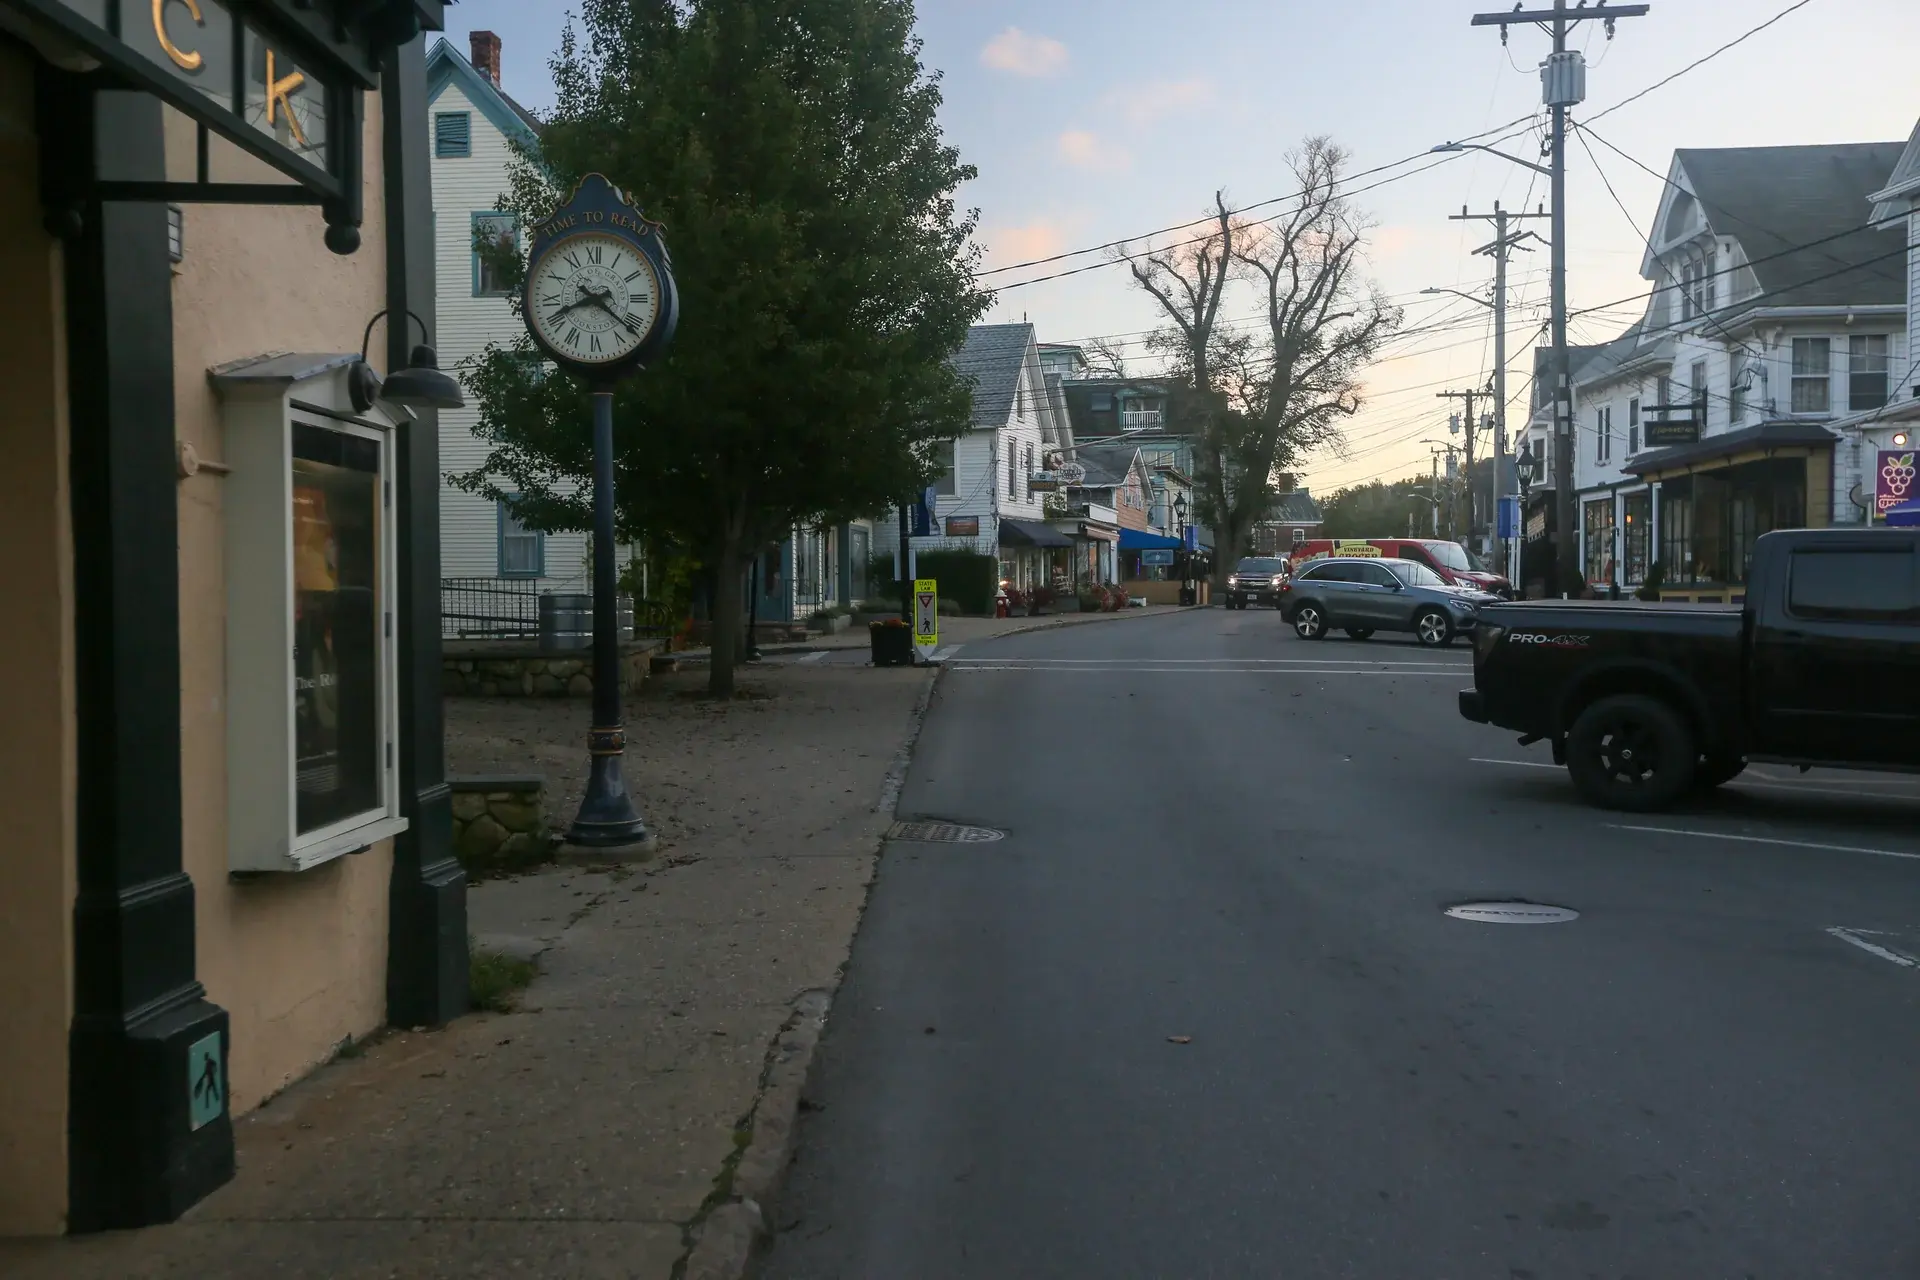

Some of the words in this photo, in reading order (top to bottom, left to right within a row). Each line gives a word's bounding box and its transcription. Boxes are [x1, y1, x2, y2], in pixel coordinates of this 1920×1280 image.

[542, 213, 578, 238] TIME
[582, 211, 604, 223] TO
[611, 212, 650, 236] READ
[586, 246, 602, 264] XII
[604, 270, 626, 301] GRAPES
[569, 311, 617, 331] BOOKSTOR
[1509, 633, 1590, 646] PRO-4X
